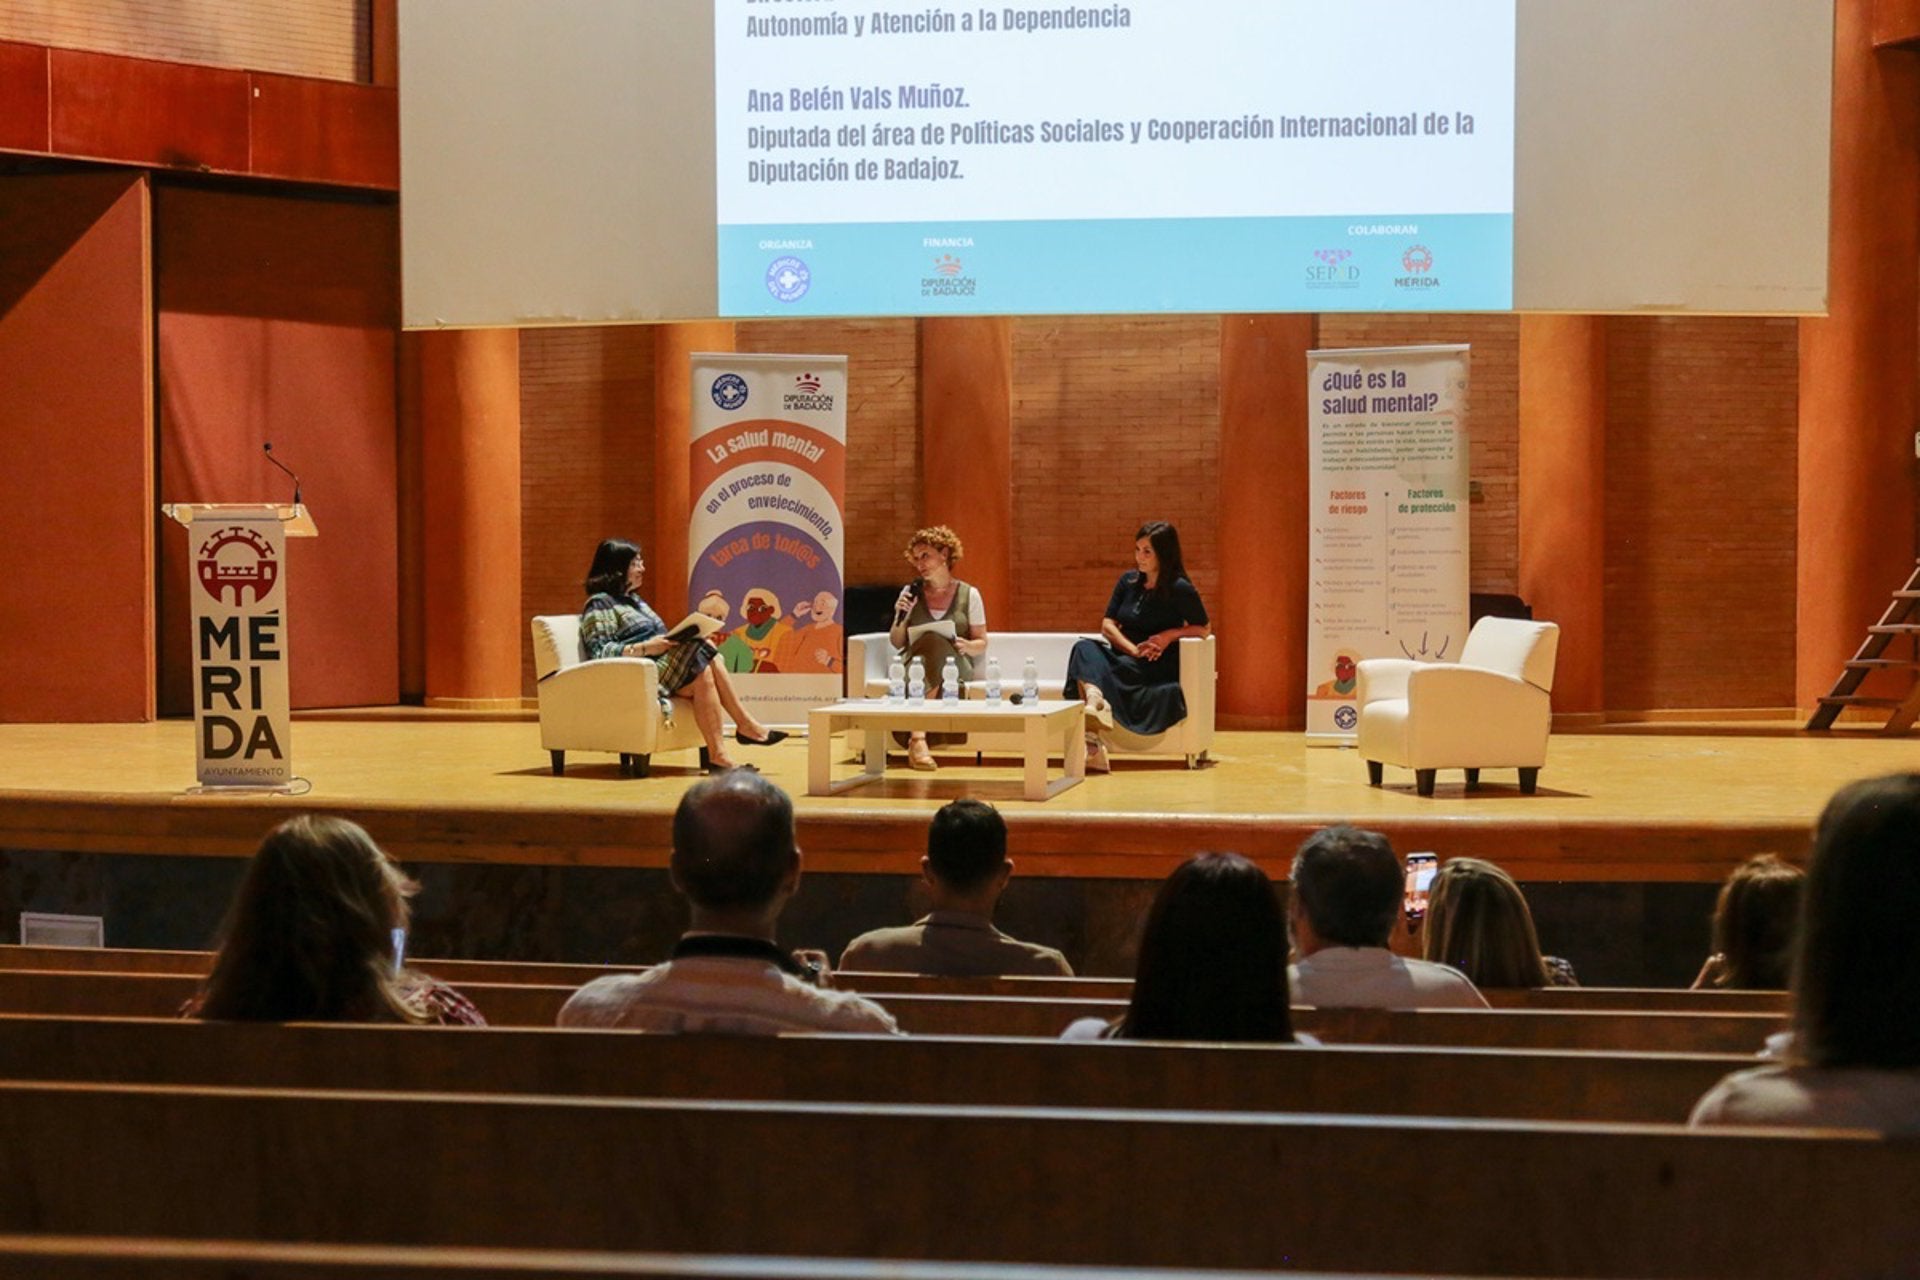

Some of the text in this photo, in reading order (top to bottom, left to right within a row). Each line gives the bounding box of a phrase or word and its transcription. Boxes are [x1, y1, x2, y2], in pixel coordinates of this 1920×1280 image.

[746, 4, 1131, 38] Autonomía y Atención a la Dependencia
[747, 84, 970, 112] Ana Belén Vals Muñoz.
[748, 111, 1474, 152] Diputada del área de Políticas Sociales y Cooperación Internacional de la
[748, 156, 964, 186] Diputación de Badajoz.
[1348, 225, 1418, 235] COLABORAN
[759, 240, 813, 249] ORGANIZA
[923, 238, 974, 247] FINANCIA
[921, 276, 976, 288] DIPUTACIÓN
[932, 287, 976, 296] BADAJOZ
[1322, 369, 1406, 391] ¿Qué es la
[783, 393, 833, 403] DIPUTACIÓN
[1322, 393, 1438, 415] salud mental?
[793, 402, 833, 411] BADAJOZ
[706, 429, 825, 464] La salud mental
[705, 473, 791, 515] en el proceso de
[1330, 490, 1366, 500] Factores
[1407, 488, 1444, 499] Factores
[1328, 503, 1368, 515] de riesgo
[1398, 501, 1456, 515] de protección
[748, 494, 832, 540] envejecimiento,
[710, 532, 821, 569] tarea de tod@s
[203, 768, 284, 776] AYUNTAMIENTO
